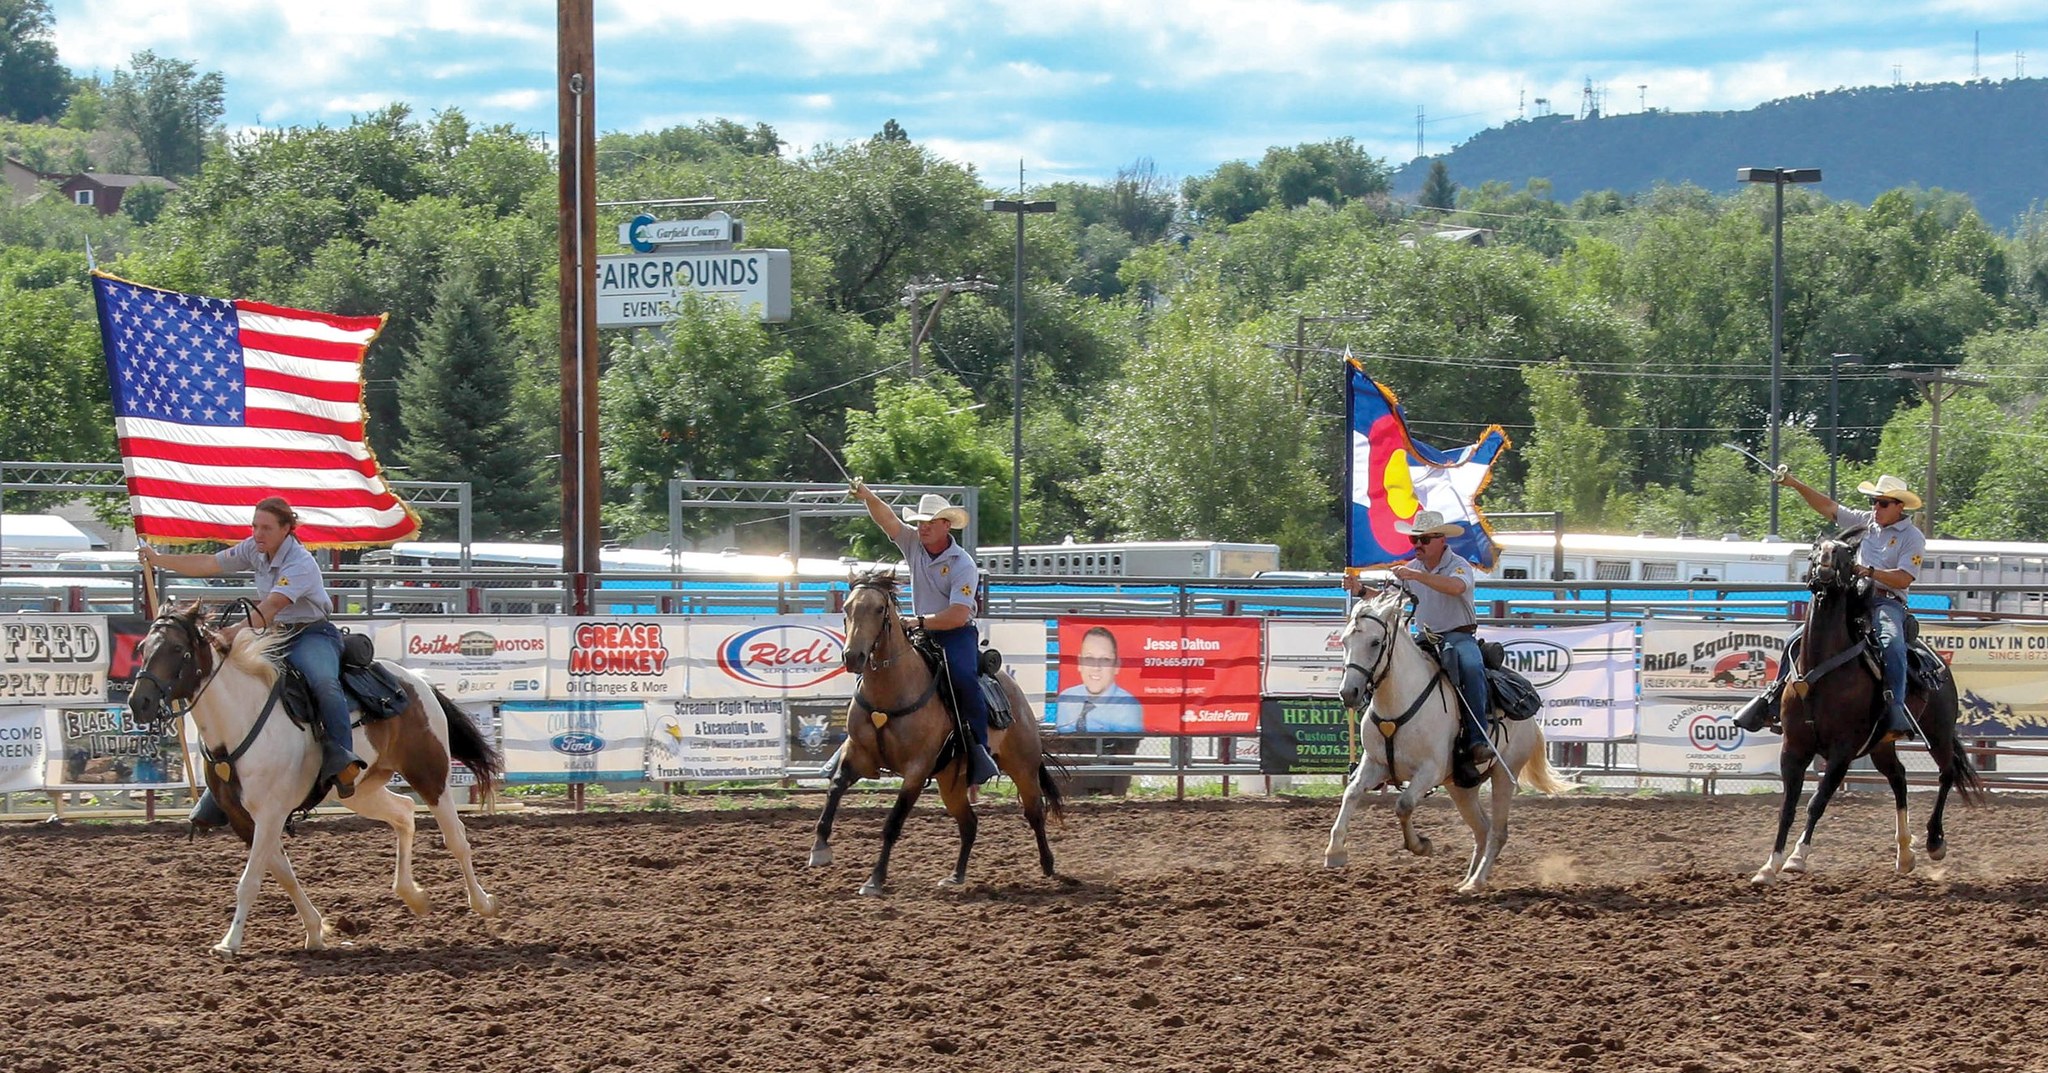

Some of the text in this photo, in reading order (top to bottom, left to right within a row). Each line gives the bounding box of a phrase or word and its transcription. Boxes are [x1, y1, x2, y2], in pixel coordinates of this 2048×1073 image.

[656, 225, 720, 240] Garfield County
[3, 622, 100, 662] FEED
[574, 623, 662, 649] GREASE
[1970, 636, 2004, 649] ONLY
[2009, 636, 2022, 649] IN
[494, 638, 545, 651] MOTORS
[1144, 638, 1220, 650] Jesse Dalton
[746, 638, 833, 667] Redi
[1988, 651, 2048, 660] SINCE 1873
[569, 649, 668, 675] MONKEY
[1644, 651, 1688, 671] Rifle
[54, 673, 98, 696] INC.
[566, 682, 668, 694] Oil Changes & More
[1644, 679, 1709, 688] RENTAL
[674, 700, 783, 716] Screamin Eagle Trucking
[1549, 699, 1616, 707] COMMITMENT.
[66, 710, 178, 739] BLACK BAR
[1667, 704, 1704, 732] ROARING
[1705, 703, 1732, 712] FORK
[702, 721, 750, 736] Excavating
[1295, 730, 1337, 741] Custom
[1695, 725, 1739, 740] COOP
[90, 735, 161, 760] LIQUORS
[561, 735, 594, 751] Ford
